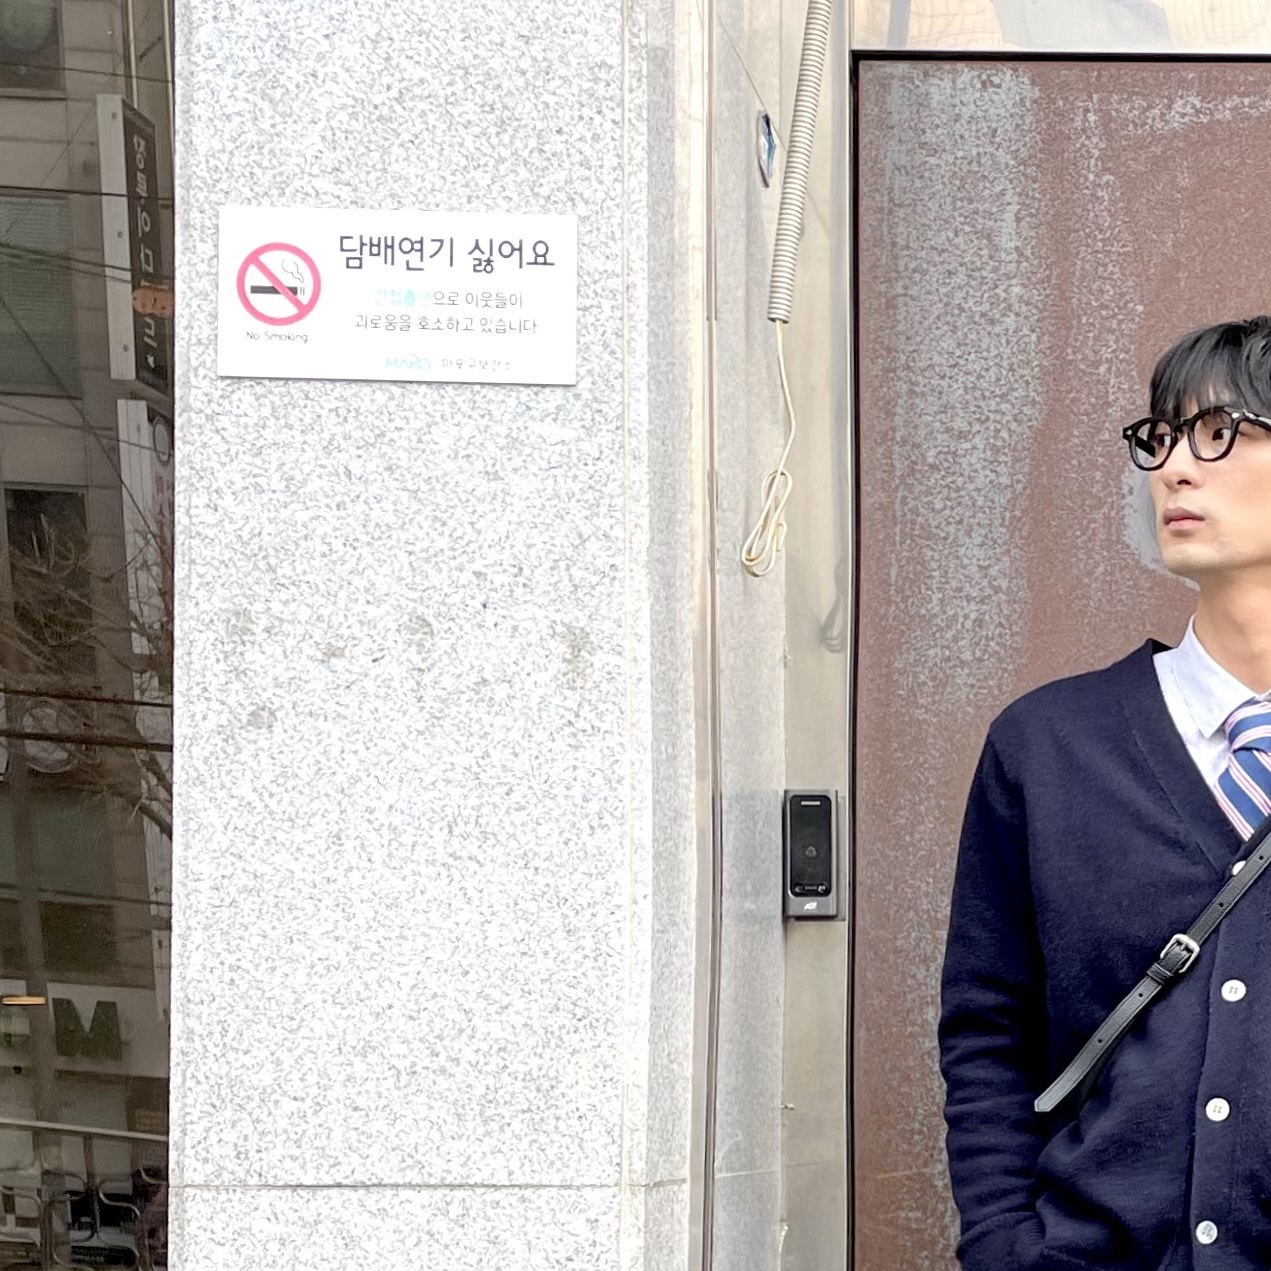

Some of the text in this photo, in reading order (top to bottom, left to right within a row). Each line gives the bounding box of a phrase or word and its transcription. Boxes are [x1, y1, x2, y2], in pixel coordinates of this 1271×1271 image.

[339, 234, 556, 275] 담배연기 싫어요
[465, 290, 523, 309] 이웃들이
[355, 313, 538, 335] 괴로움을 호소하고 있습니다
[245, 330, 309, 345] No Smoking
